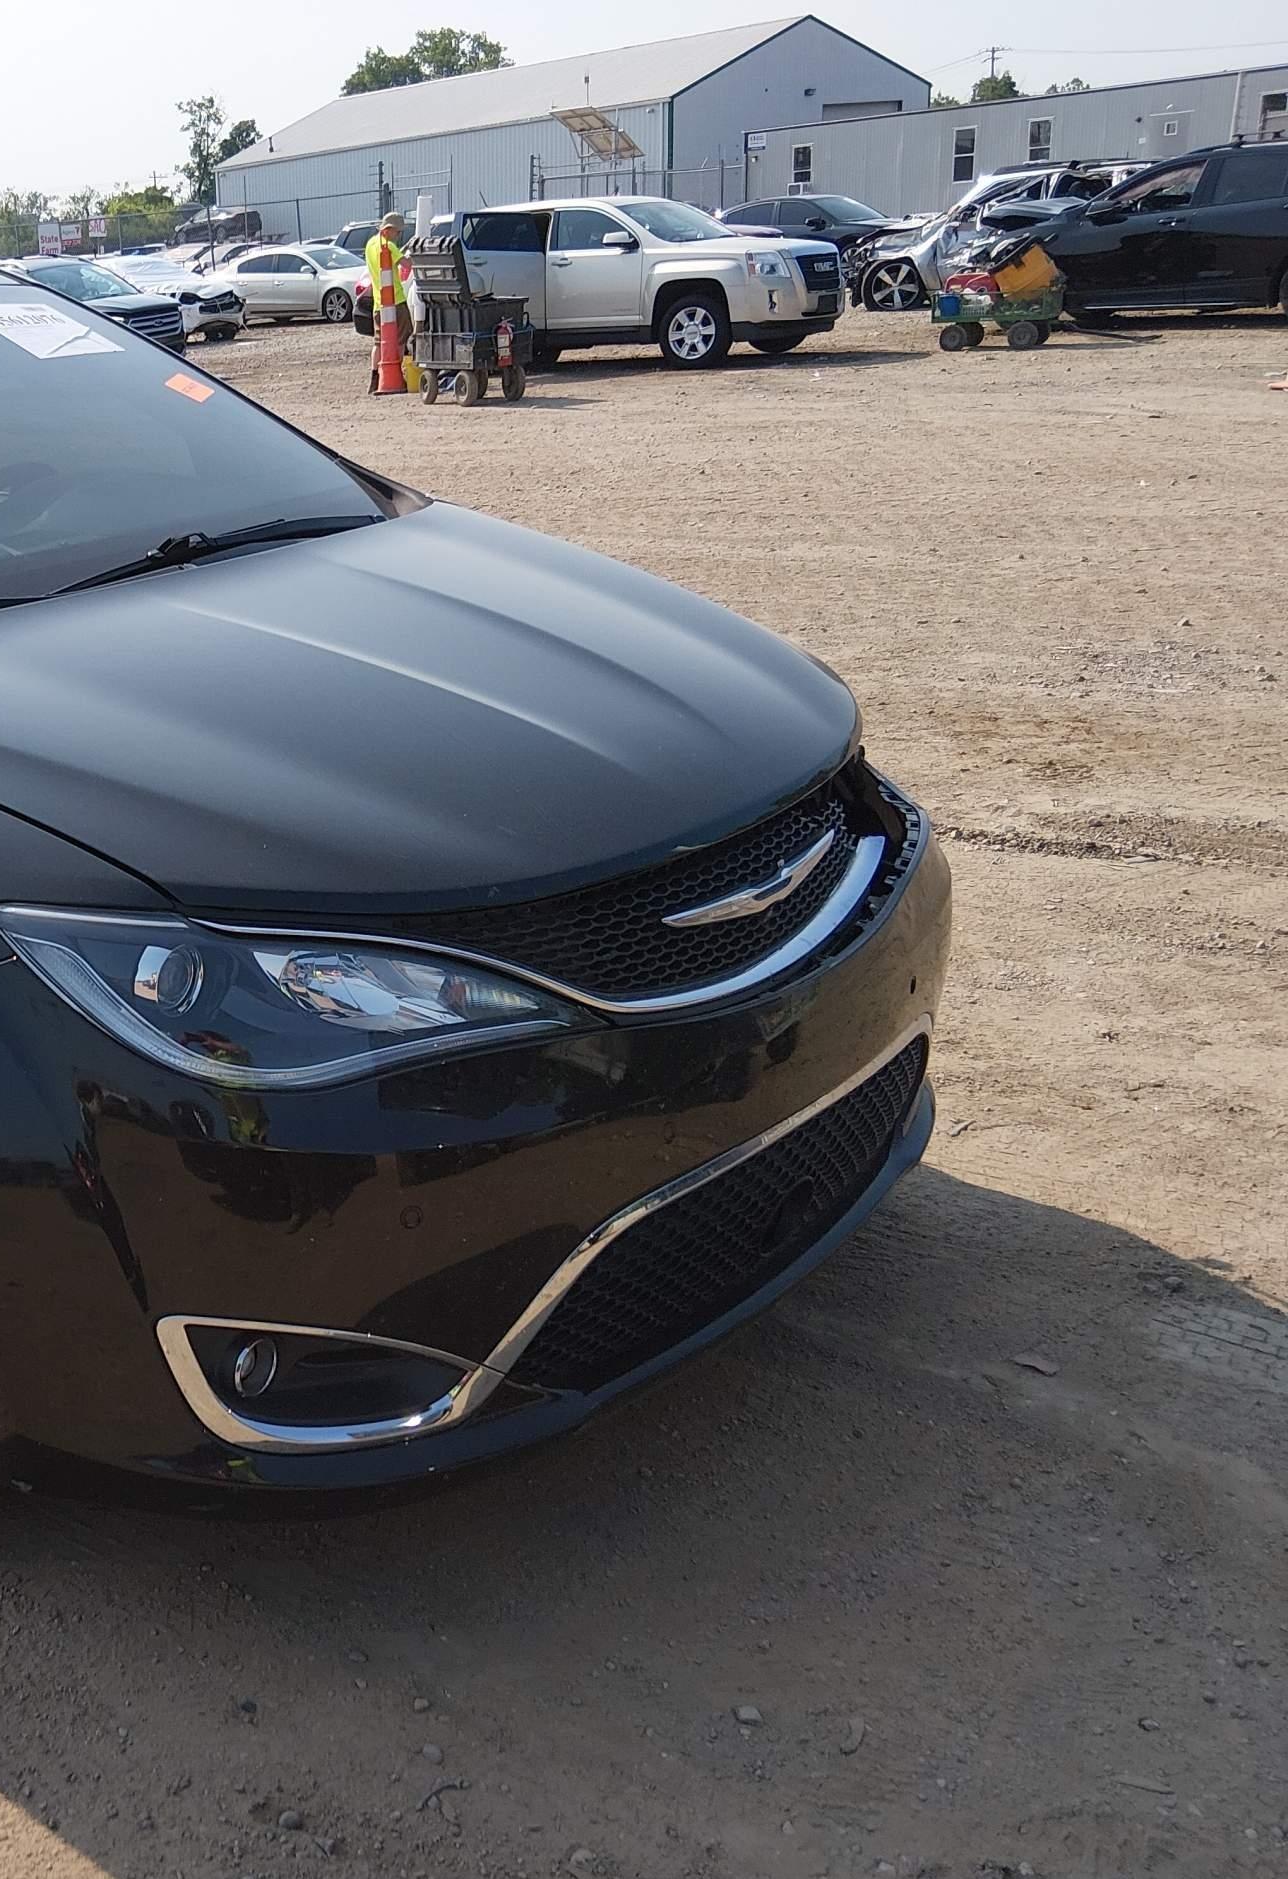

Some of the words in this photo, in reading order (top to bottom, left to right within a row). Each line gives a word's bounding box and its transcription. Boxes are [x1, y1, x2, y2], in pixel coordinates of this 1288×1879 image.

[40, 235, 59, 243] State
[41, 246, 59, 255] Farm
[814, 261, 834, 272] GMC
